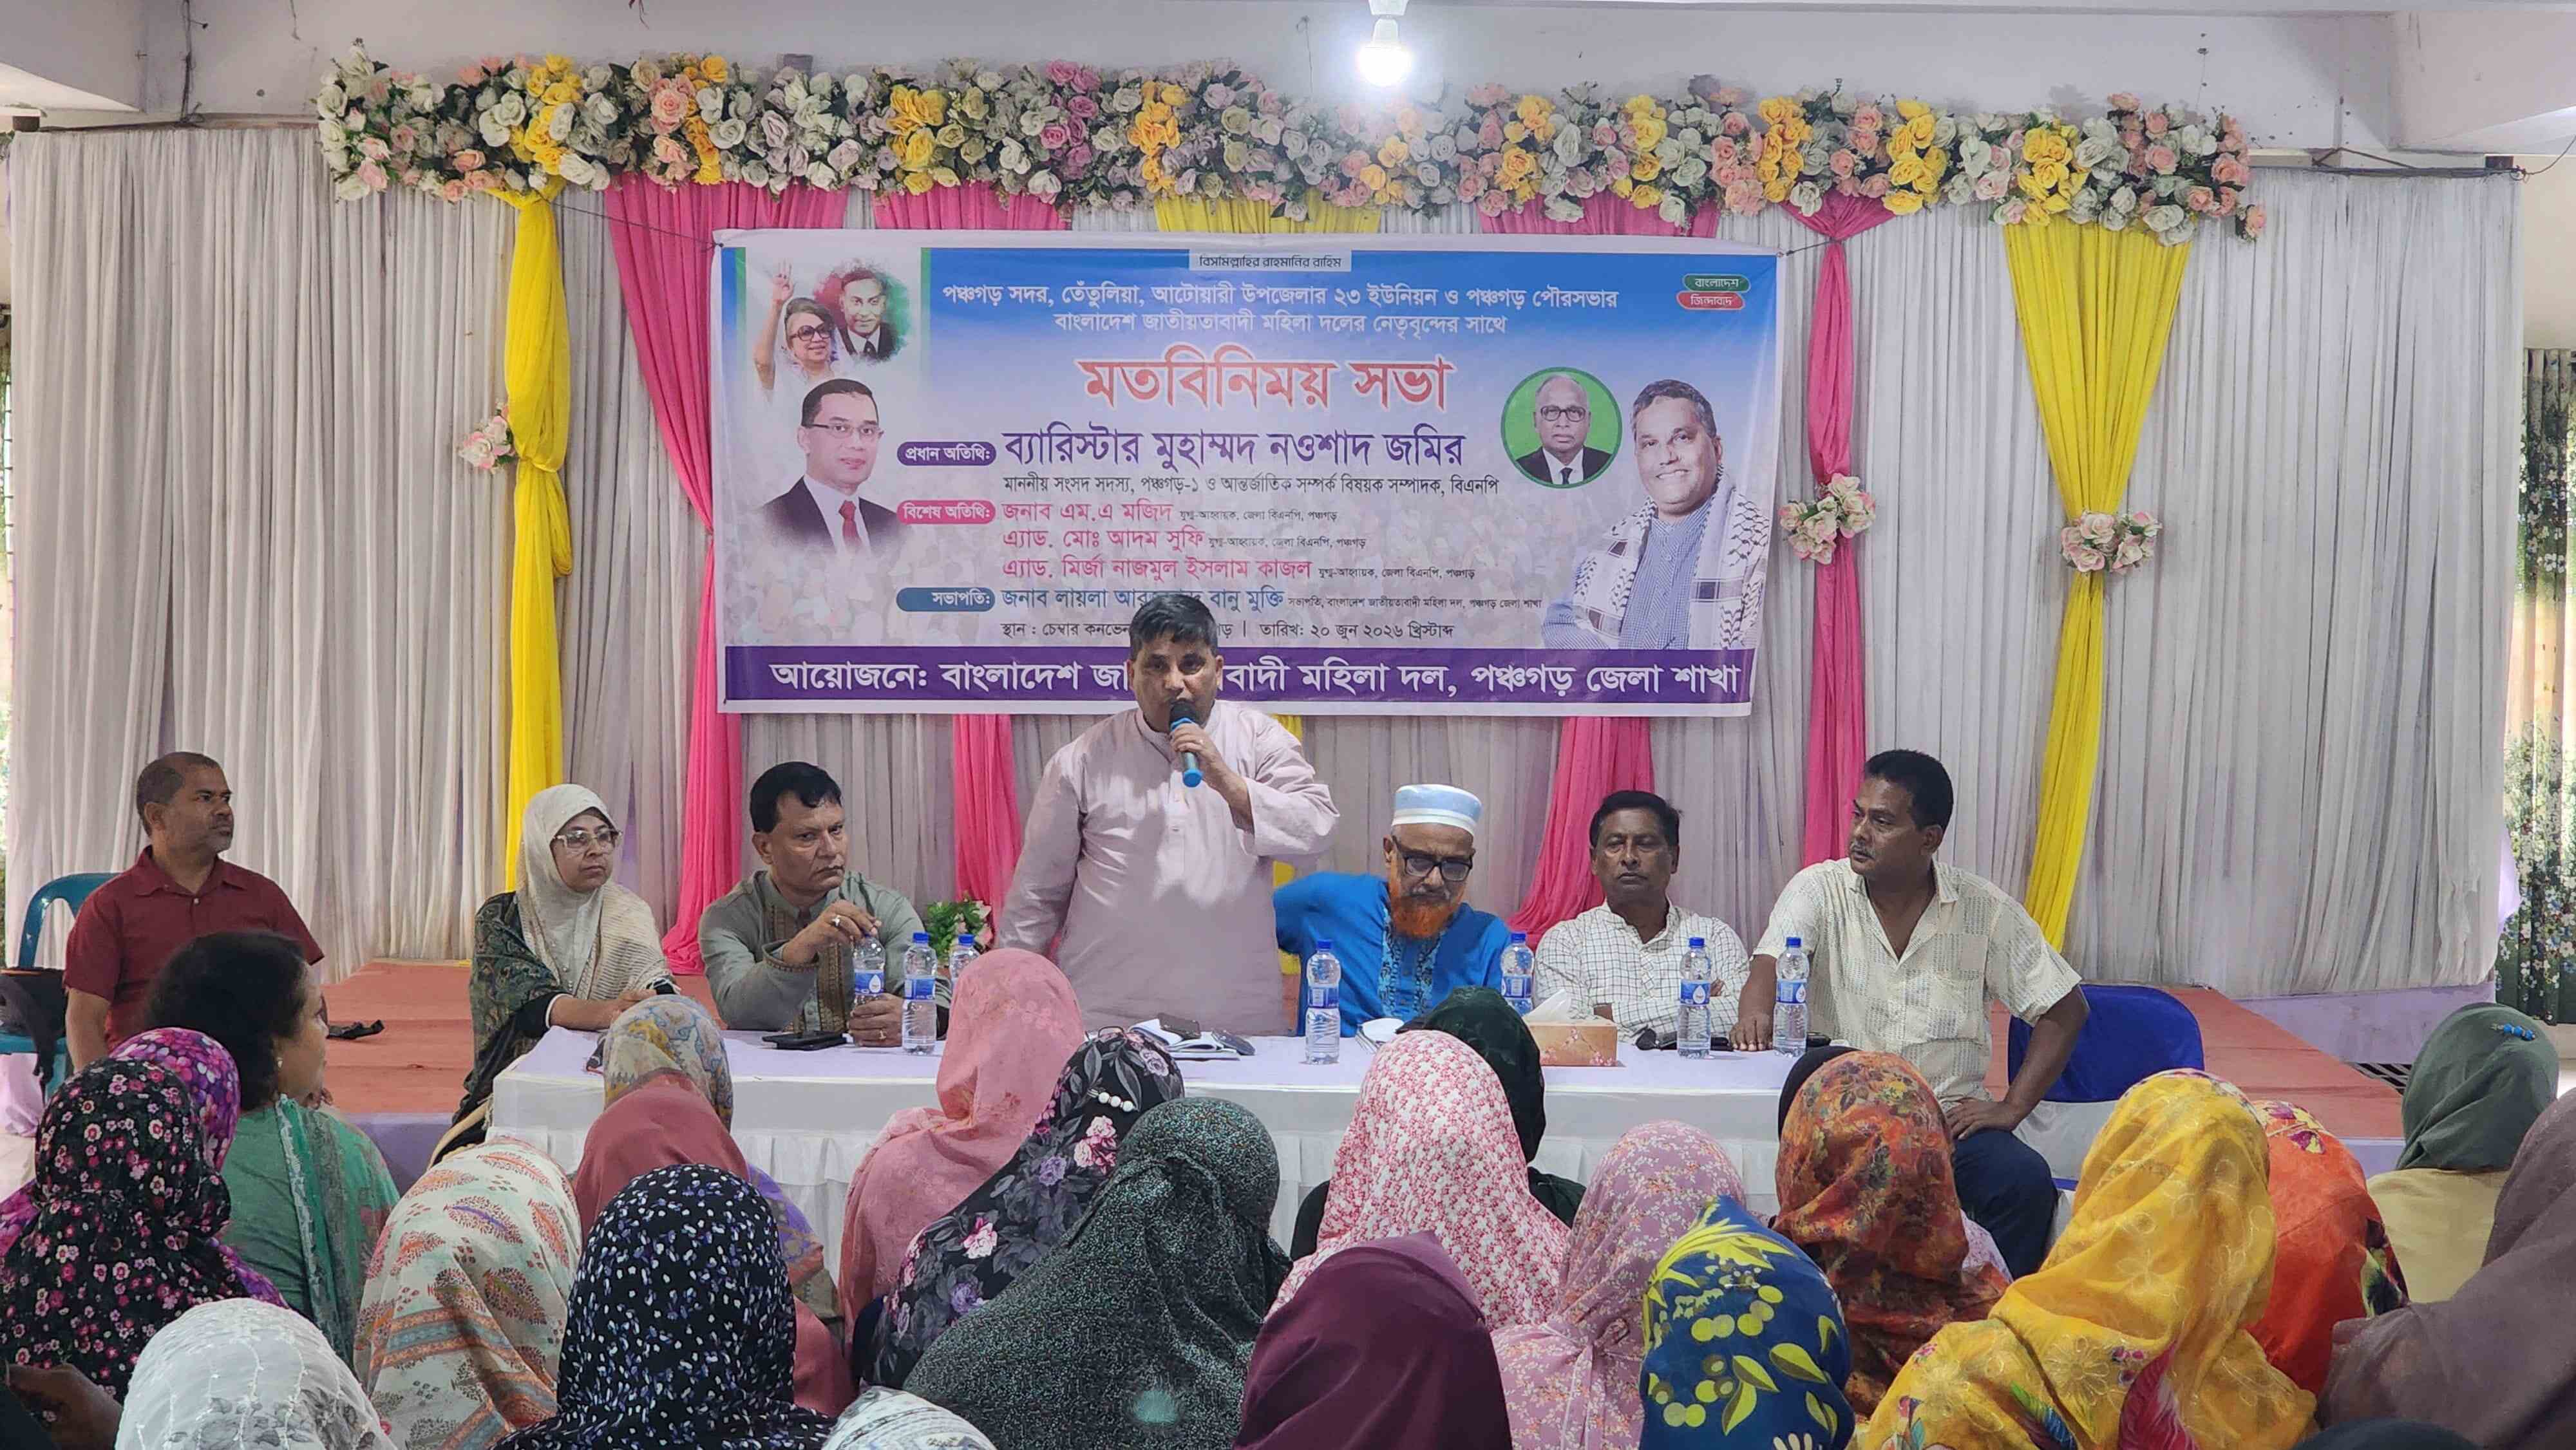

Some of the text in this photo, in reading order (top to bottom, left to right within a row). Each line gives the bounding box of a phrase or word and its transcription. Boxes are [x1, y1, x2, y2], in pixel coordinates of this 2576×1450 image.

[1312, 255, 1341, 267] রাহিম
[942, 280, 1619, 310] পঞ্চগড় সদর, তেঁতুলিয়া, আটোয়ারী উপজেলার ২৩ ইউনিয়ন ও পঞ্চগড় পৌরসভার
[1694, 278, 1739, 288] বাংলাদেশ
[1052, 308, 1508, 340] বাংলাদেশ জাতীয়তাবাদী মহিলা দলের নেতৃবৃন্দের সাথে
[1075, 343, 1457, 411] মতবিনিময় সভা
[905, 446, 940, 462] প্রধান
[1001, 420, 1466, 473] ব্যারিস্টার মুহাম্মদ নওশাদ জমির
[1003, 471, 1500, 497] মাননীয় সংসদ সদস্য, পঞ্চগড়-১ ও আন্তর্জাতিক সম্পর্ক বিষয়ক সম্পাদক, বিএনপি
[903, 502, 942, 520] বিশেষ
[1001, 502, 1052, 521] জনাব
[1061, 504, 1113, 522] এম.এ
[1121, 498, 1174, 522] মজিদ
[1003, 530, 1054, 548] এ্যাড.
[1063, 529, 1099, 547] মোঃ
[1107, 529, 1159, 548] আদম
[1166, 524, 1208, 552] সুফি
[1003, 558, 1053, 578] এ্যাড.
[1061, 553, 1106, 578] মির্জা
[1112, 559, 1179, 583] নাজমুল
[1184, 556, 1250, 579] ইসলাম
[1256, 558, 1313, 579] কাজল
[1381, 568, 1403, 578] জেলা
[1001, 588, 1047, 608] জনাব
[1054, 588, 1108, 608] লায়লা
[1209, 588, 1240, 612] বানু
[1246, 585, 1285, 613] মুক্তি
[1327, 598, 1365, 608] বাংলাদেশ
[1368, 595, 1419, 608] জাতীয়তাবাদী
[1423, 595, 1446, 608] মহিলা
[1000, 623, 1027, 639] স্থান
[1042, 622, 1080, 636] চেম্বার
[1311, 624, 1330, 639] ২০
[1336, 623, 1358, 640] জুন
[1363, 624, 1403, 639] ২০২৬
[1406, 620, 1455, 639] খ্রিস্টাব্দ
[769, 661, 927, 691] আয়োজনে:
[937, 661, 1083, 692] বাংলাদেশ
[1297, 655, 1391, 696] মহিলা
[1396, 665, 1457, 698] দল,
[1472, 664, 1577, 697] পঞ্চগড়
[1586, 664, 1665, 693] জেলা
[1671, 664, 1741, 694] শাখা
